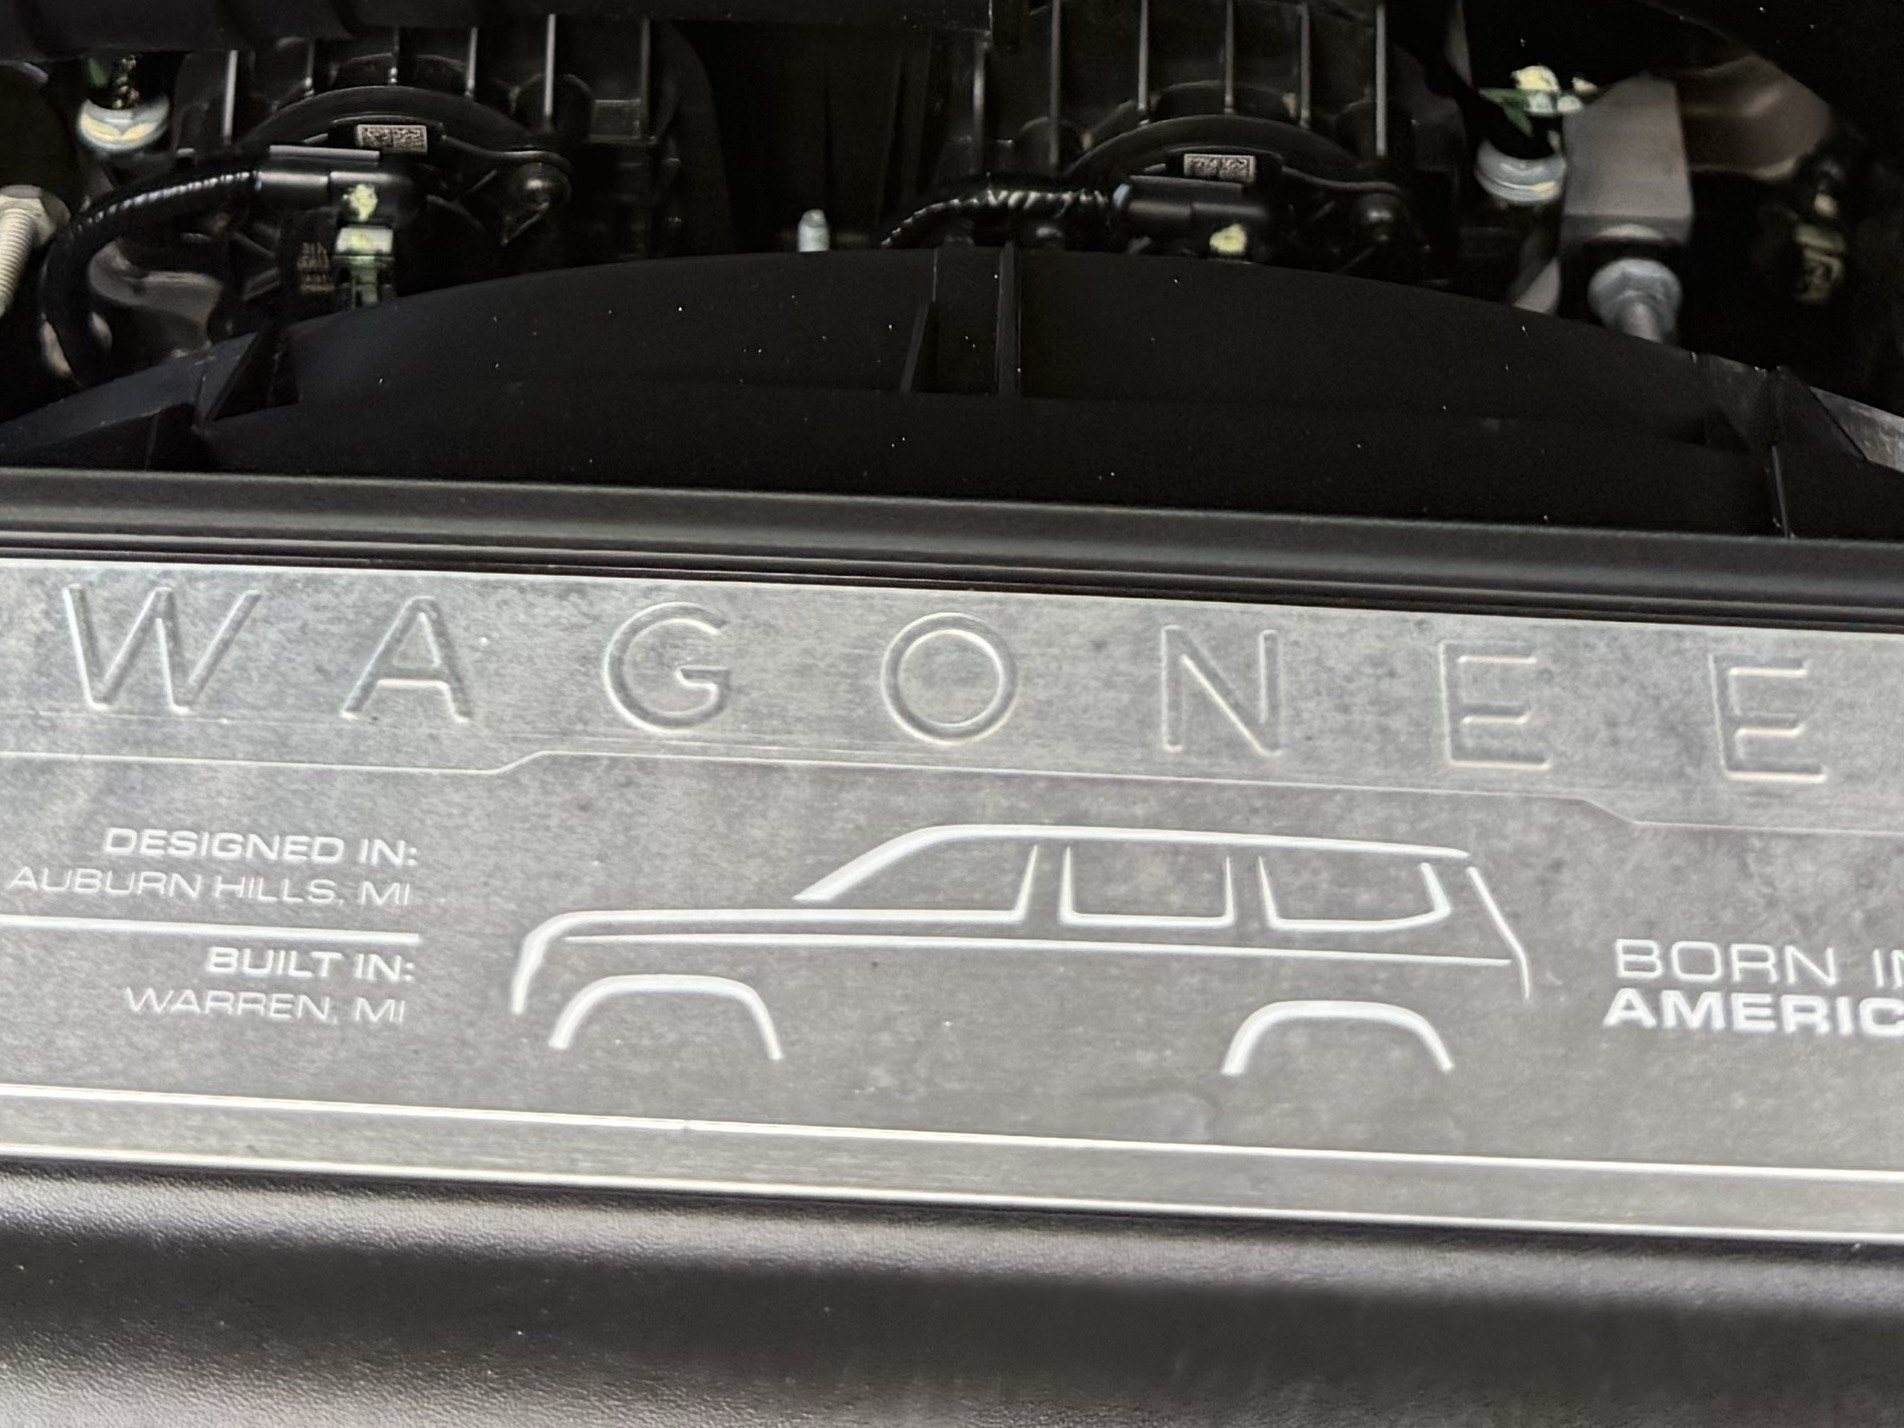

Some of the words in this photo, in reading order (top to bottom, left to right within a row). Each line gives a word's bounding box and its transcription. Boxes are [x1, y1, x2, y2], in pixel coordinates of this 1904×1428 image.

[103, 827, 345, 865] DESIGNED
[357, 838, 419, 867] IN:
[7, 865, 201, 900] AUBURN
[213, 875, 345, 907] HILLS,
[357, 881, 411, 907] MI
[203, 945, 344, 980] BUILT
[351, 952, 416, 983] IN:
[1616, 938, 1838, 987] BORN
[125, 986, 339, 1026] WARREN,
[353, 996, 406, 1025] MI
